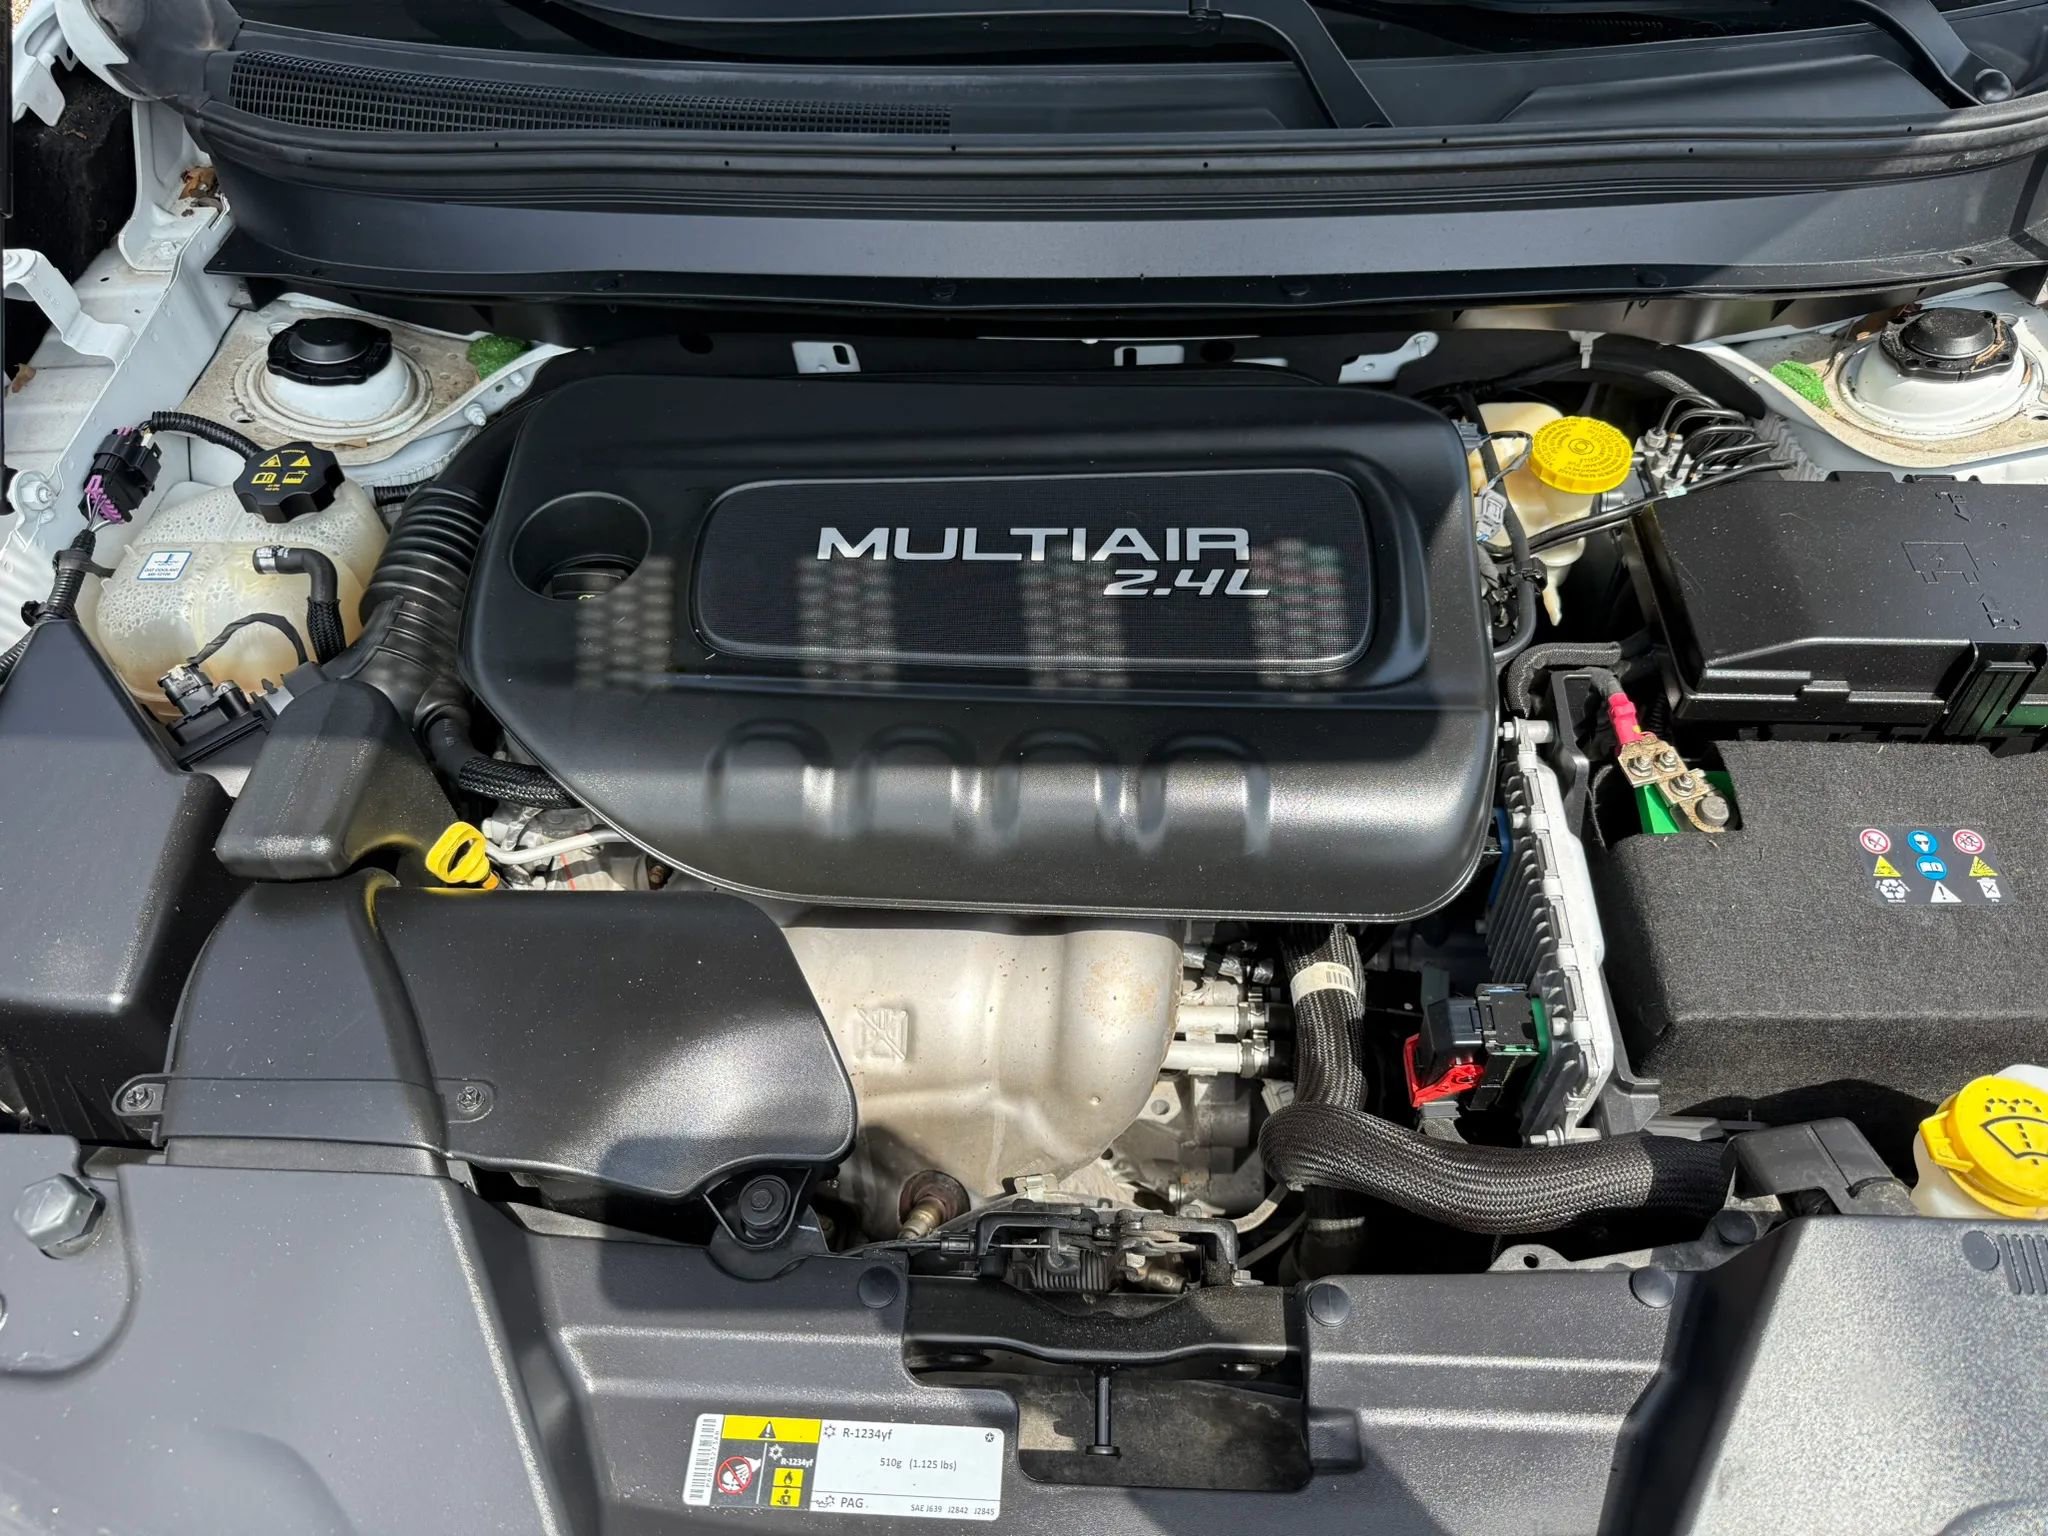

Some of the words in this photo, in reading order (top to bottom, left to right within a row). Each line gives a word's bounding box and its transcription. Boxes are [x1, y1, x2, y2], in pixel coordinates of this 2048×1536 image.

[816, 527, 1251, 561] MULTIAIR
[1103, 568, 1270, 597] 2.4L
[842, 1427, 893, 1442] R-1234yf
[780, 1458, 814, 1468] R-1234yf
[879, 1457, 902, 1469] 510g
[909, 1458, 938, 1470] (1.125
[940, 1460, 957, 1472] lbs)
[840, 1497, 864, 1508] PAG
[910, 1504, 925, 1512] SAE
[926, 1504, 943, 1513] J639
[947, 1506, 969, 1514] J2842
[974, 1507, 995, 1516] J2845
